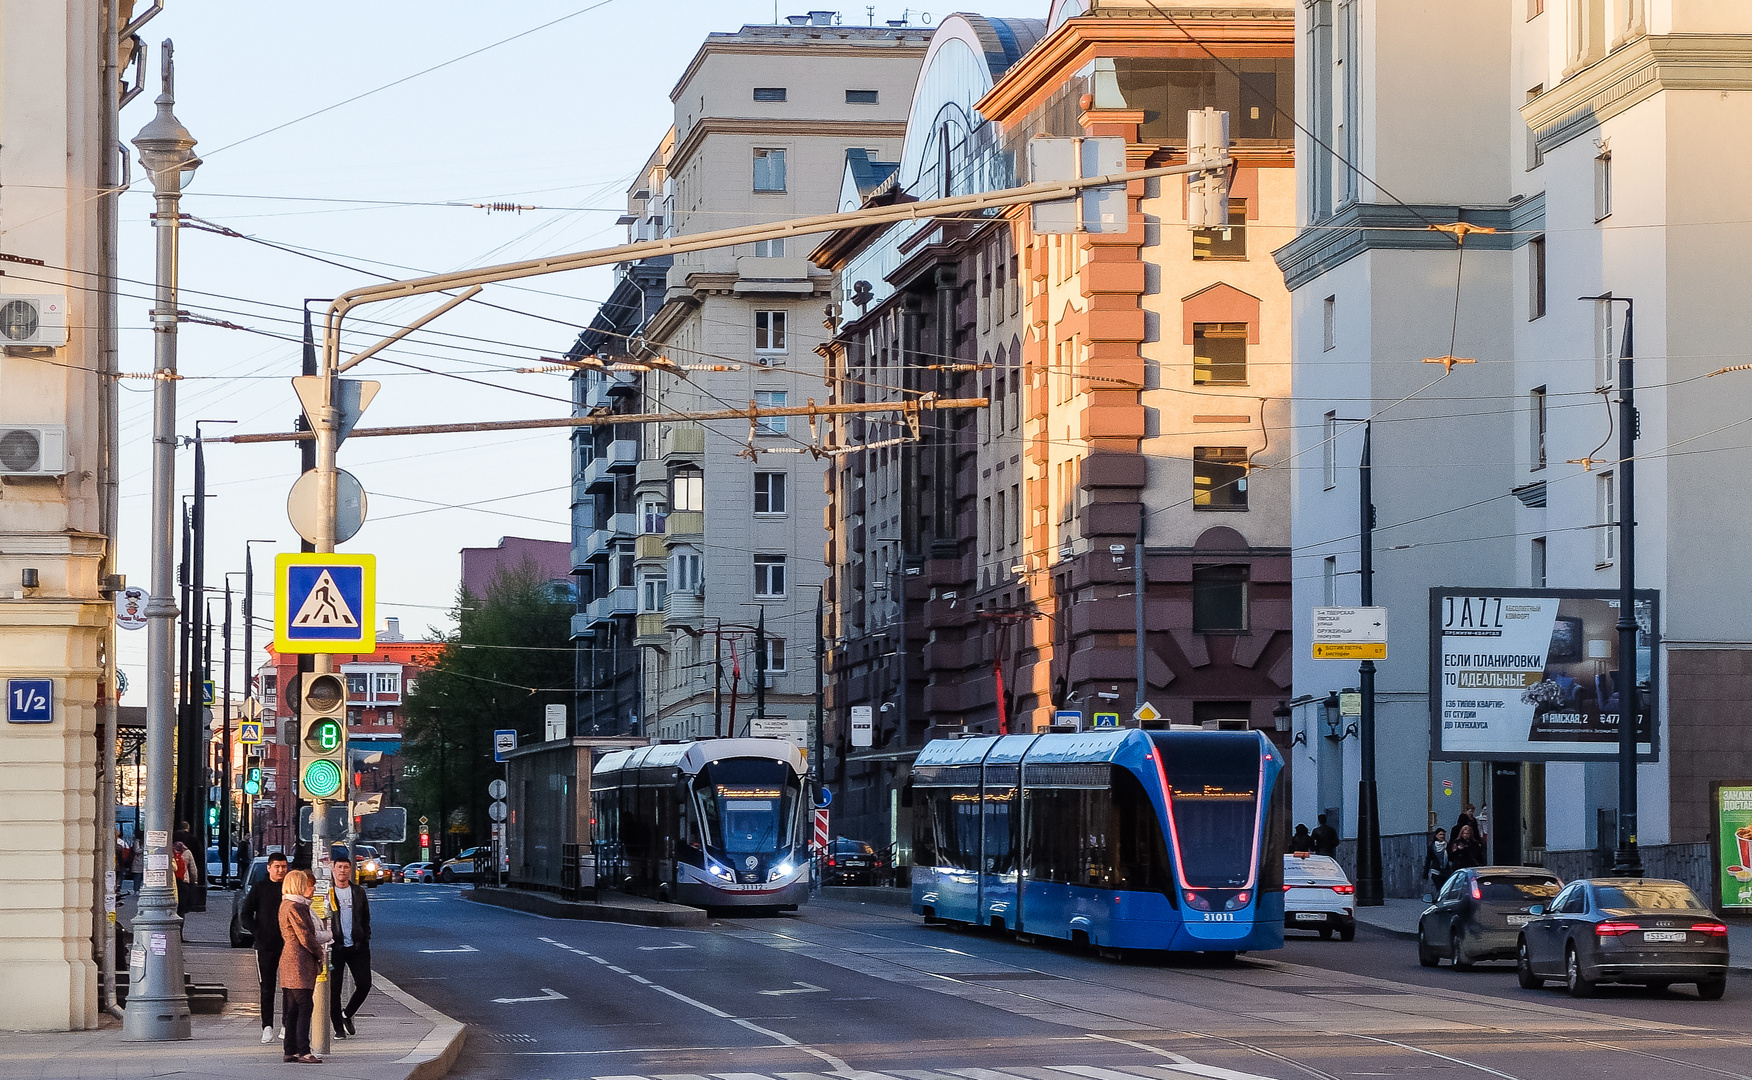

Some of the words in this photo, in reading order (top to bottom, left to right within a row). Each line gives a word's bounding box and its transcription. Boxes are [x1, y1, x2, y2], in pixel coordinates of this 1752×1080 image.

[1445, 597, 1503, 627] JAZZ
[1445, 654, 1470, 667] ЕСЛИ
[1474, 655, 1544, 669] ПЛАНИРОВКИ,
[1445, 673, 1456, 685] ТО
[1461, 674, 1526, 687] ИДЕАЛЬНЫЕ
[14, 688, 46, 712] 1/2
[1452, 710, 1476, 719] СТУДИИ
[1582, 714, 1588, 724] 2
[1444, 722, 1453, 730] ДО
[322, 724, 336, 748] 8
[1204, 914, 1234, 922] 31011
